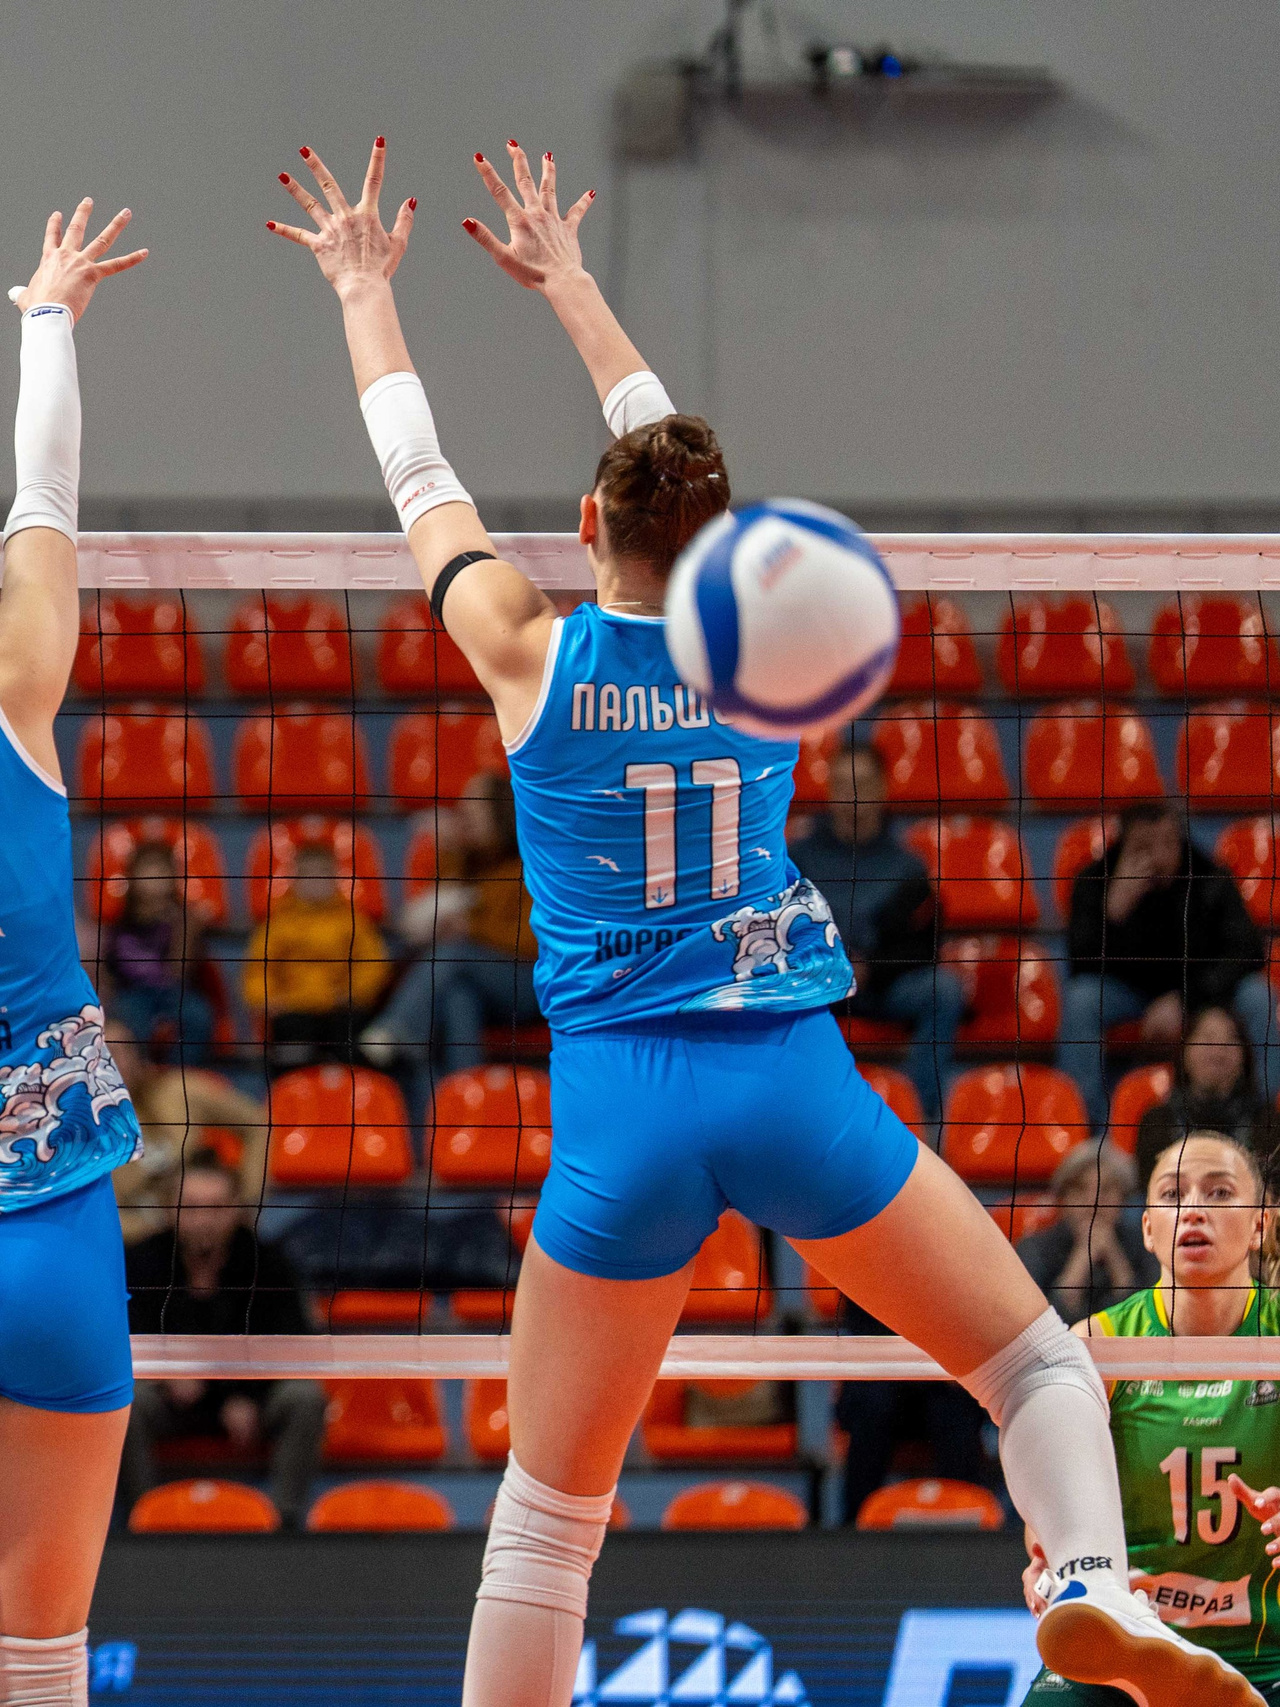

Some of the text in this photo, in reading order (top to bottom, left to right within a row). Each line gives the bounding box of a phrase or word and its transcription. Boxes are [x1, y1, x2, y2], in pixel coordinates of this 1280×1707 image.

[624, 757, 742, 910] 11
[1159, 1447, 1242, 1546] 15
[1155, 1586, 1234, 1615] ЕВРАЗ
